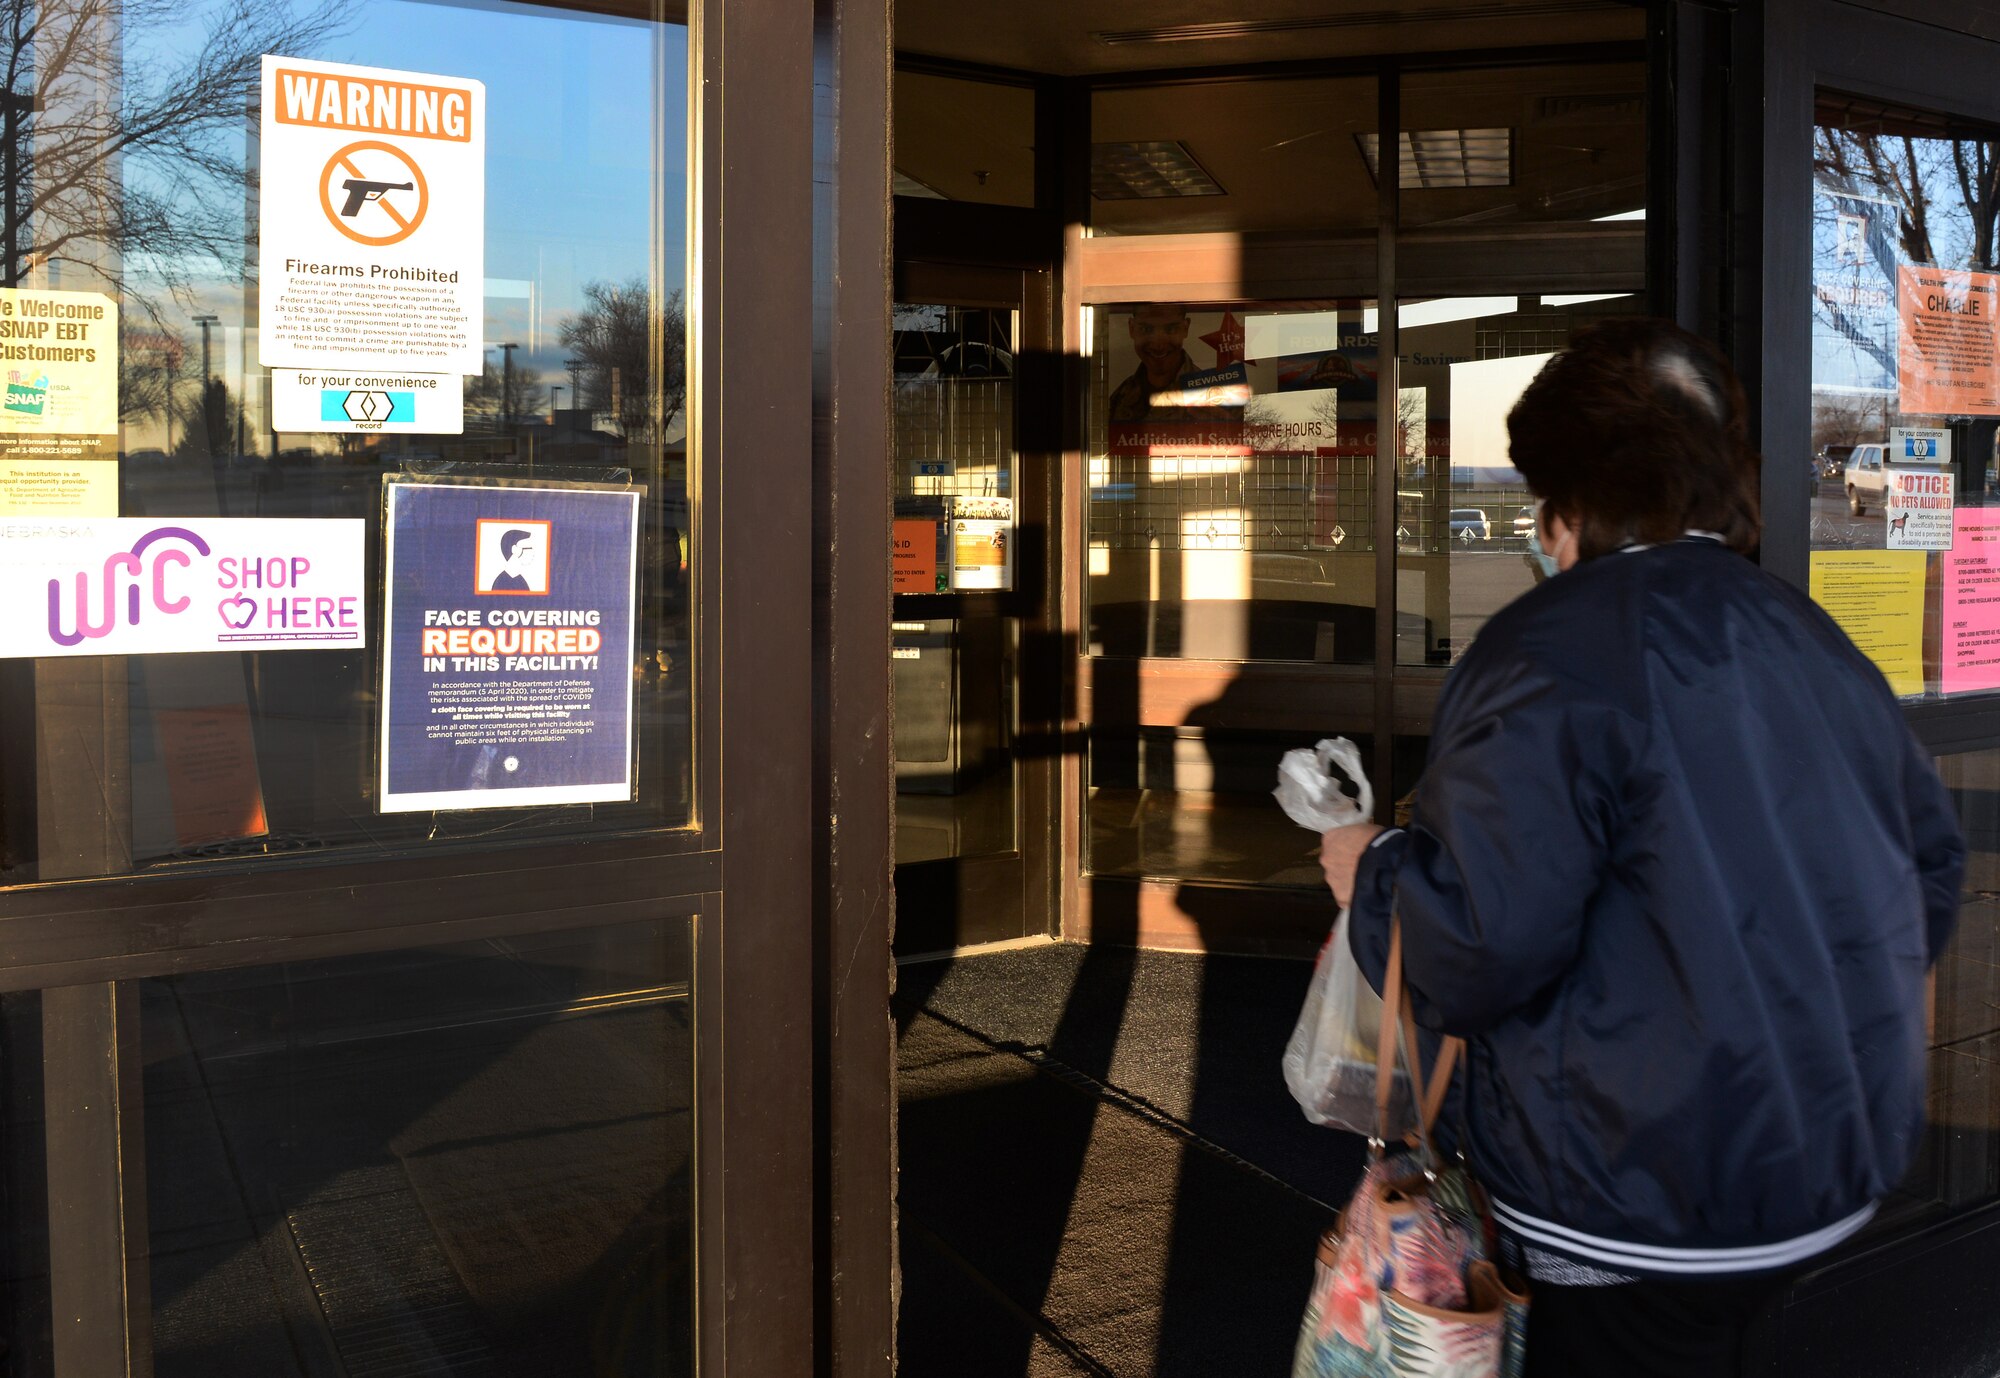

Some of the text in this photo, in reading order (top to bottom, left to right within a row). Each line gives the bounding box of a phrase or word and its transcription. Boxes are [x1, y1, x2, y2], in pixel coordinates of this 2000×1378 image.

[283, 74, 465, 137] WARNING
[286, 259, 458, 283] Firearms Prohibited
[290, 278, 320, 286] Federal
[340, 282, 375, 290] prohibits
[393, 286, 437, 294] possession
[1842, 275, 1887, 289] COVERING
[288, 287, 318, 295] firearm
[355, 292, 397, 300] dangerous
[1817, 284, 1889, 308] REQUIRED
[0, 299, 104, 320] e Welcome
[280, 296, 311, 304] Federal
[314, 298, 341, 306] facility
[372, 303, 417, 311] specifically
[420, 304, 461, 313] authorized
[1827, 303, 1847, 315] THIS
[1927, 294, 1980, 316] CHARLIE
[0, 320, 89, 341] SNAP EBT
[1222, 332, 1241, 343] It's
[298, 374, 437, 389] for your convenience
[1187, 370, 1240, 388] REWARDS
[5, 393, 45, 405] SNAP
[1249, 421, 1322, 439] STORE HOURS
[1916, 430, 1943, 438] convenience
[1117, 433, 1203, 447] Additional
[1901, 495, 1919, 509] PETS
[1919, 496, 1951, 510] ALLOWED
[902, 540, 911, 548] ID
[1901, 539, 1922, 547] disability
[218, 557, 311, 589] SHOP
[267, 597, 358, 629] HERE
[424, 610, 600, 626] FACE COVERING
[423, 628, 601, 656] REQUIRED
[423, 655, 598, 673] IN THIS FACILITY!
[441, 681, 482, 689] accordance
[499, 680, 511, 688] the
[512, 680, 553, 689] Department
[563, 679, 591, 687] Defense
[478, 688, 487, 696] (5
[487, 688, 505, 696] April
[505, 687, 529, 696] 2020),
[566, 686, 594, 695] mitigate
[461, 695, 498, 703] associated
[499, 694, 515, 702] with
[529, 694, 552, 702] spread
[553, 693, 562, 701] of
[562, 693, 592, 701] COVID19
[457, 705, 473, 713] face
[474, 705, 505, 714] covering
[514, 704, 544, 713] required
[553, 703, 563, 711] be
[452, 713, 462, 721] all
[484, 712, 504, 720] while
[504, 711, 531, 720] visiting
[531, 711, 545, 719] this
[546, 711, 571, 719] facility
[426, 724, 440, 732] and
[449, 723, 458, 731] all
[479, 722, 528, 730] circumstances
[454, 730, 484, 738] maintain
[512, 728, 520, 736] of
[521, 728, 549, 737] physical
[550, 727, 584, 736] distancing
[455, 737, 477, 745] public
